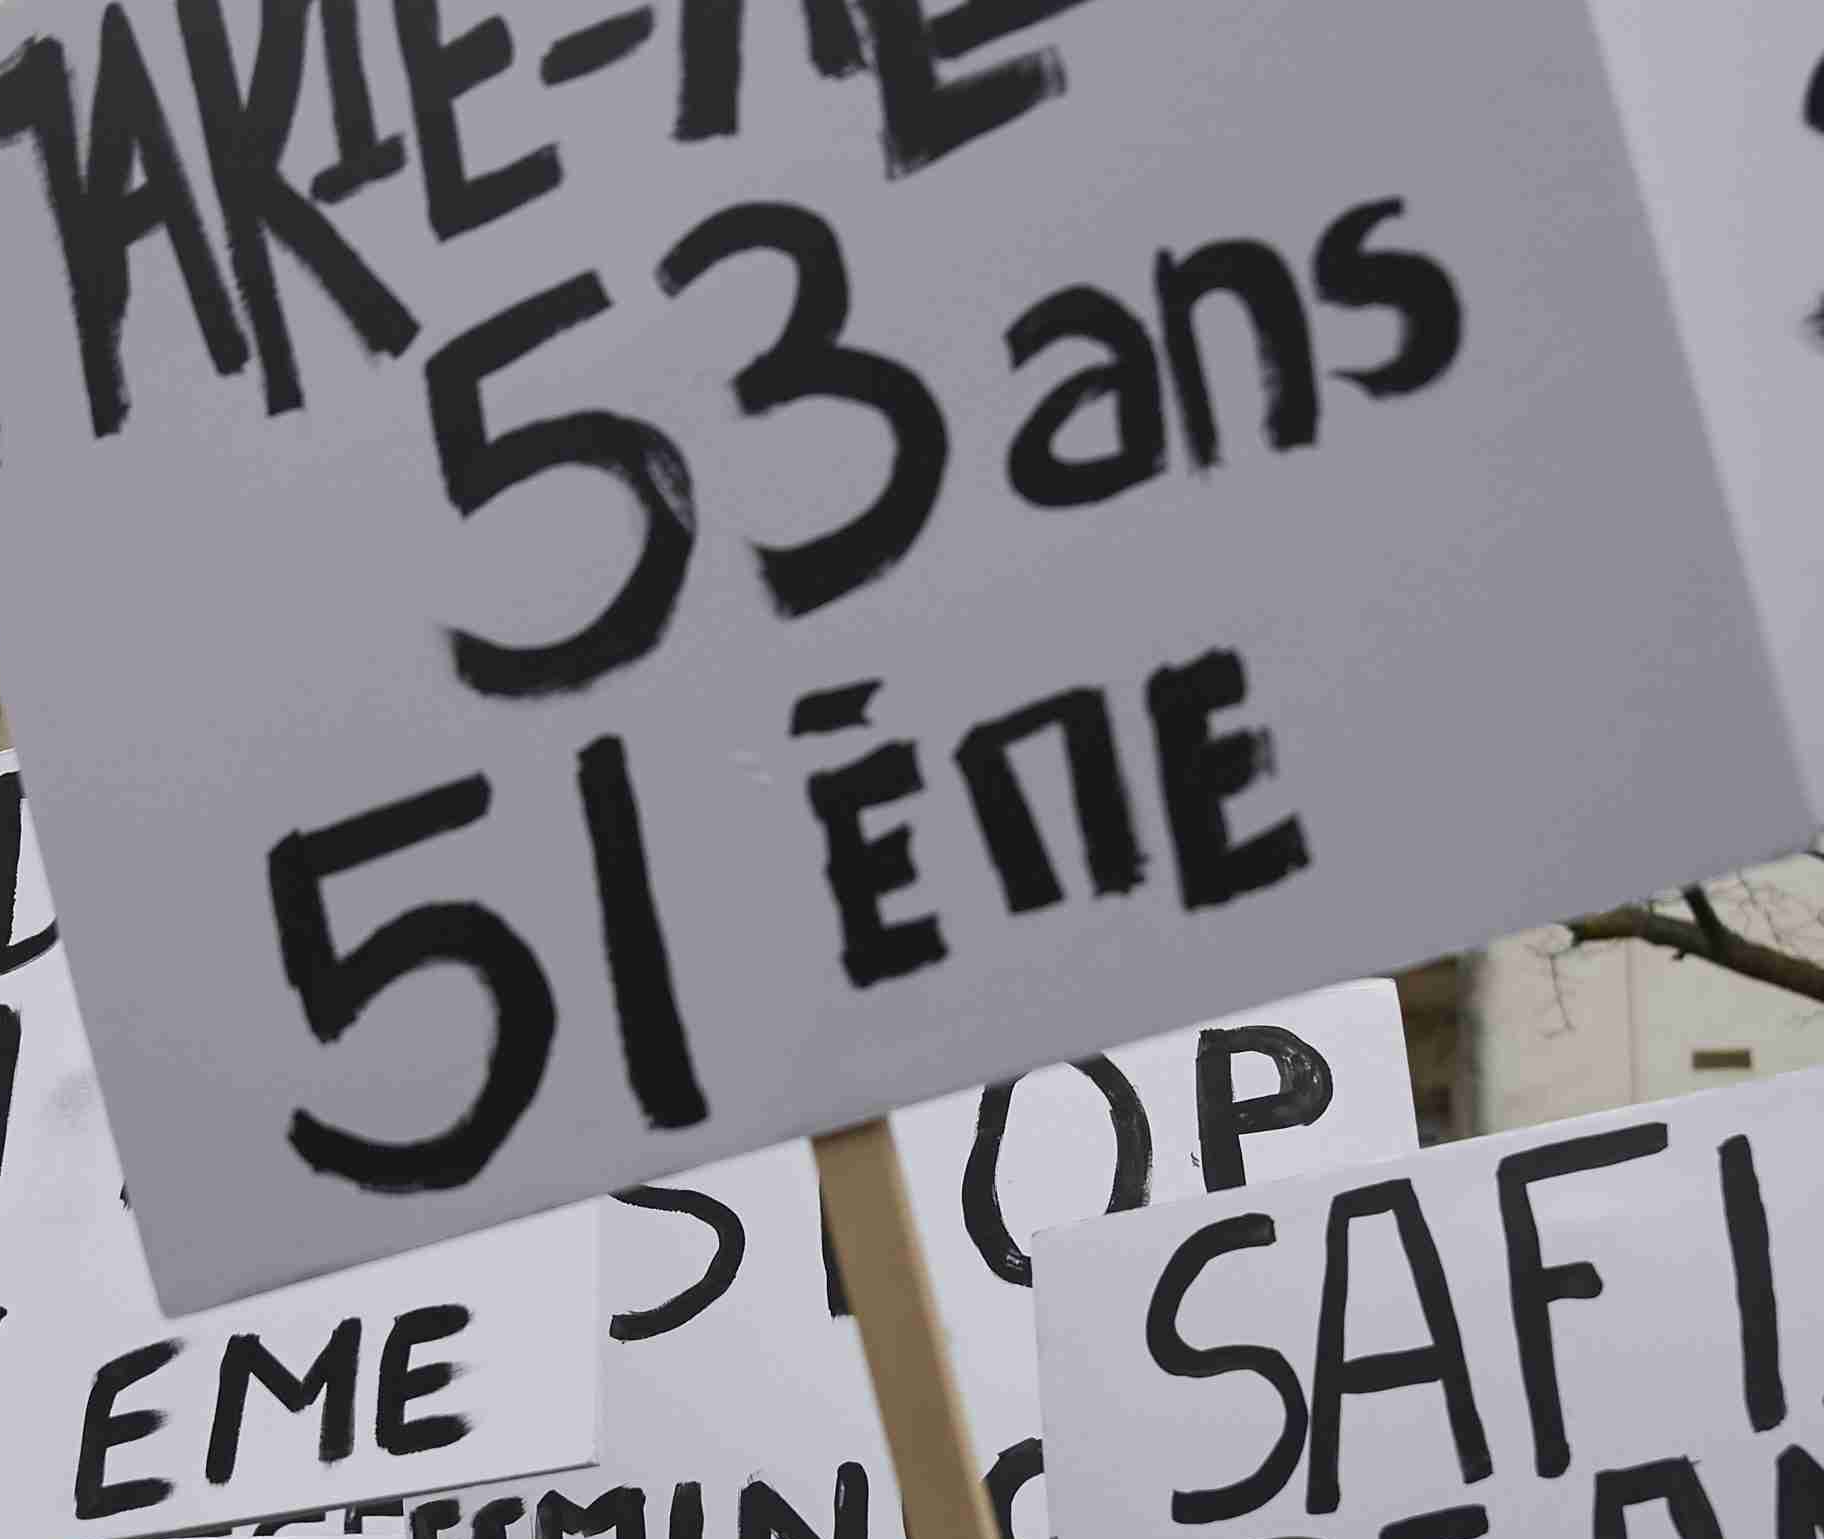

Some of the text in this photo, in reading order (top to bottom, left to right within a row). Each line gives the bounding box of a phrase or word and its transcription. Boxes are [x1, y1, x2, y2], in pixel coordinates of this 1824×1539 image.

[424, 194, 1466, 698] 53 ans
[267, 734, 710, 1194] 51
[73, 1302, 476, 1521] EME
